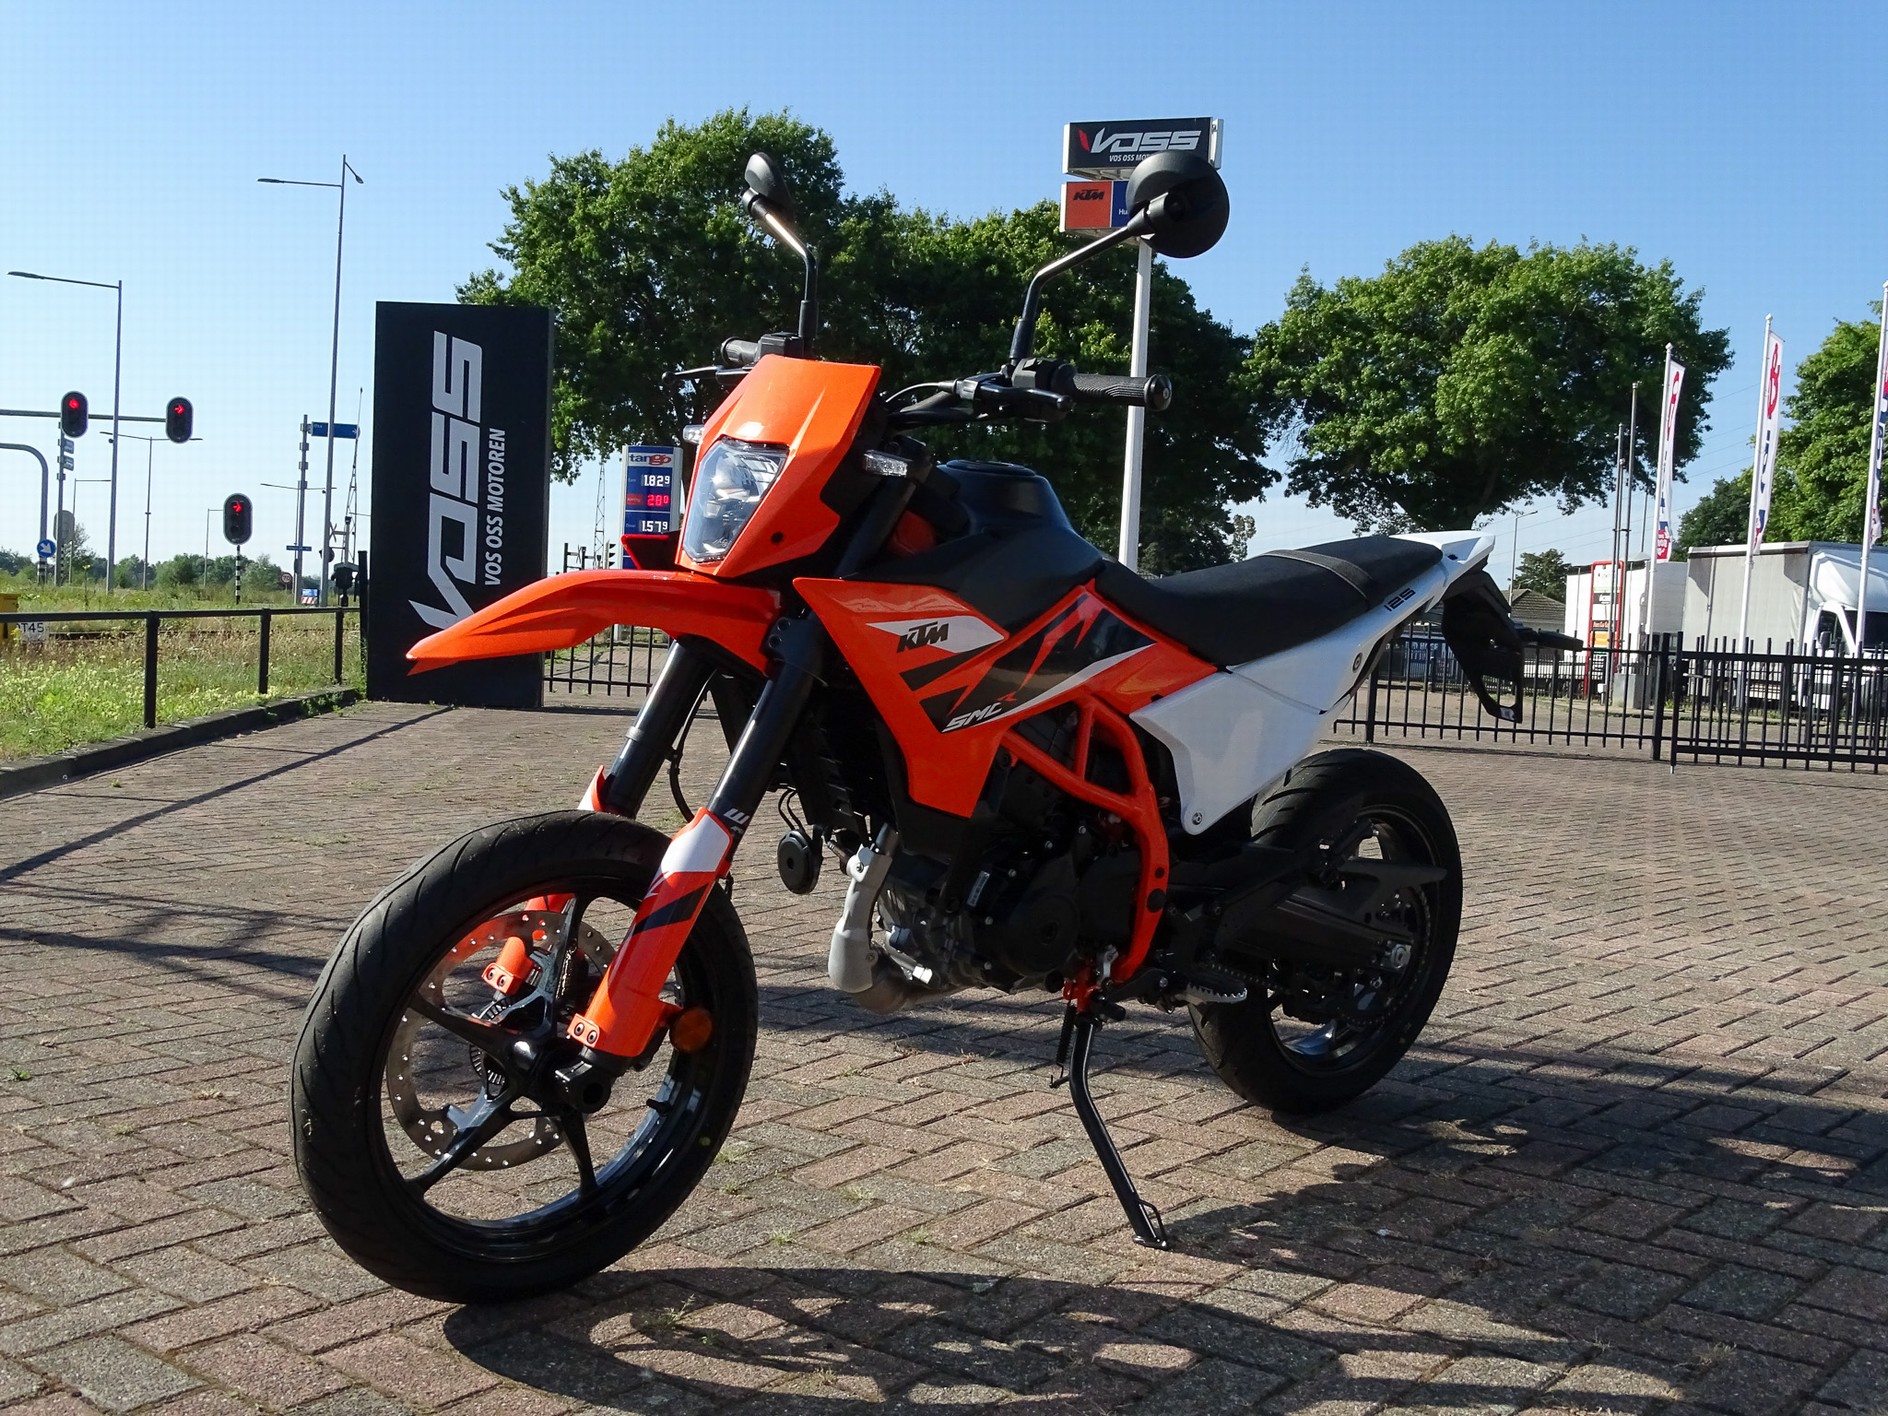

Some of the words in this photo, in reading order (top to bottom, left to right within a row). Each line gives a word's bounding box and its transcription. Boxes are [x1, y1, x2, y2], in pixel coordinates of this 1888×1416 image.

[1078, 127, 1201, 154] VOSS
[1109, 154, 1122, 162] VOS
[1122, 154, 1135, 162] OSS
[1073, 189, 1104, 201] KTM
[487, 428, 506, 513] MOTOREN
[629, 453, 672, 466] tango
[408, 330, 482, 632] VOSS
[486, 515, 504, 549] OSS
[484, 551, 502, 585] VOS
[1384, 587, 1416, 612] 125
[896, 621, 949, 653] KTM
[941, 702, 1002, 733] SMC
